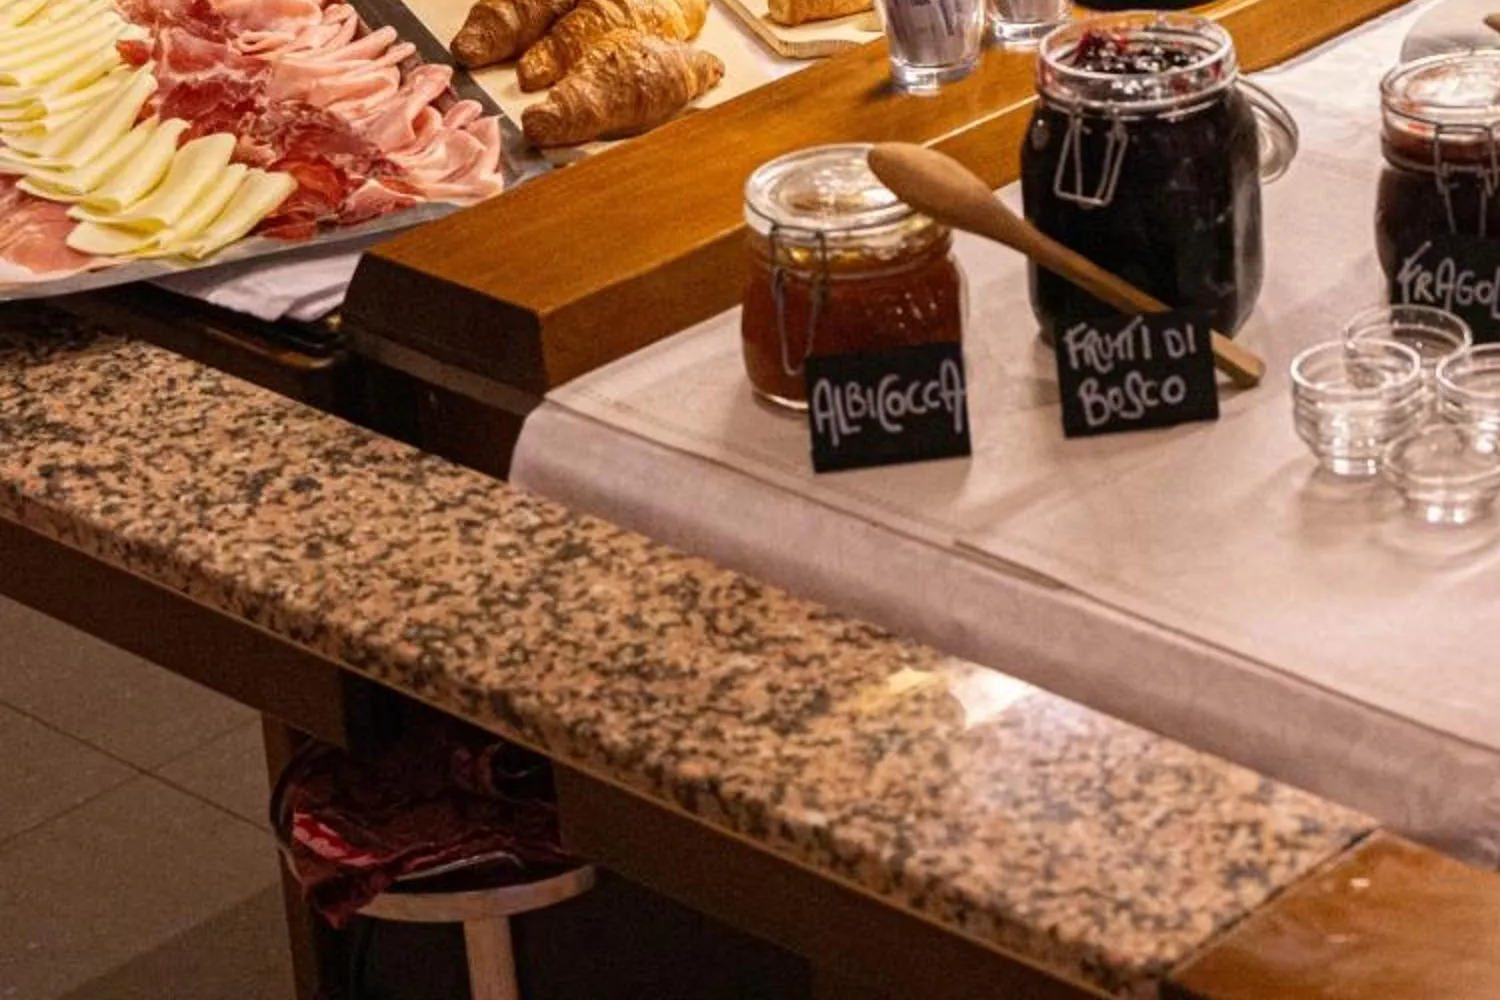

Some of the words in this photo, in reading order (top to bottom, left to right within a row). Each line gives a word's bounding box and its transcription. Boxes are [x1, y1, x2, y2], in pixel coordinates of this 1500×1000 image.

[1063, 315, 1152, 373] FRUTTI
[1163, 323, 1197, 358] DI
[812, 358, 967, 447] ALBICOCCA
[1078, 370, 1187, 426] BOSCO
